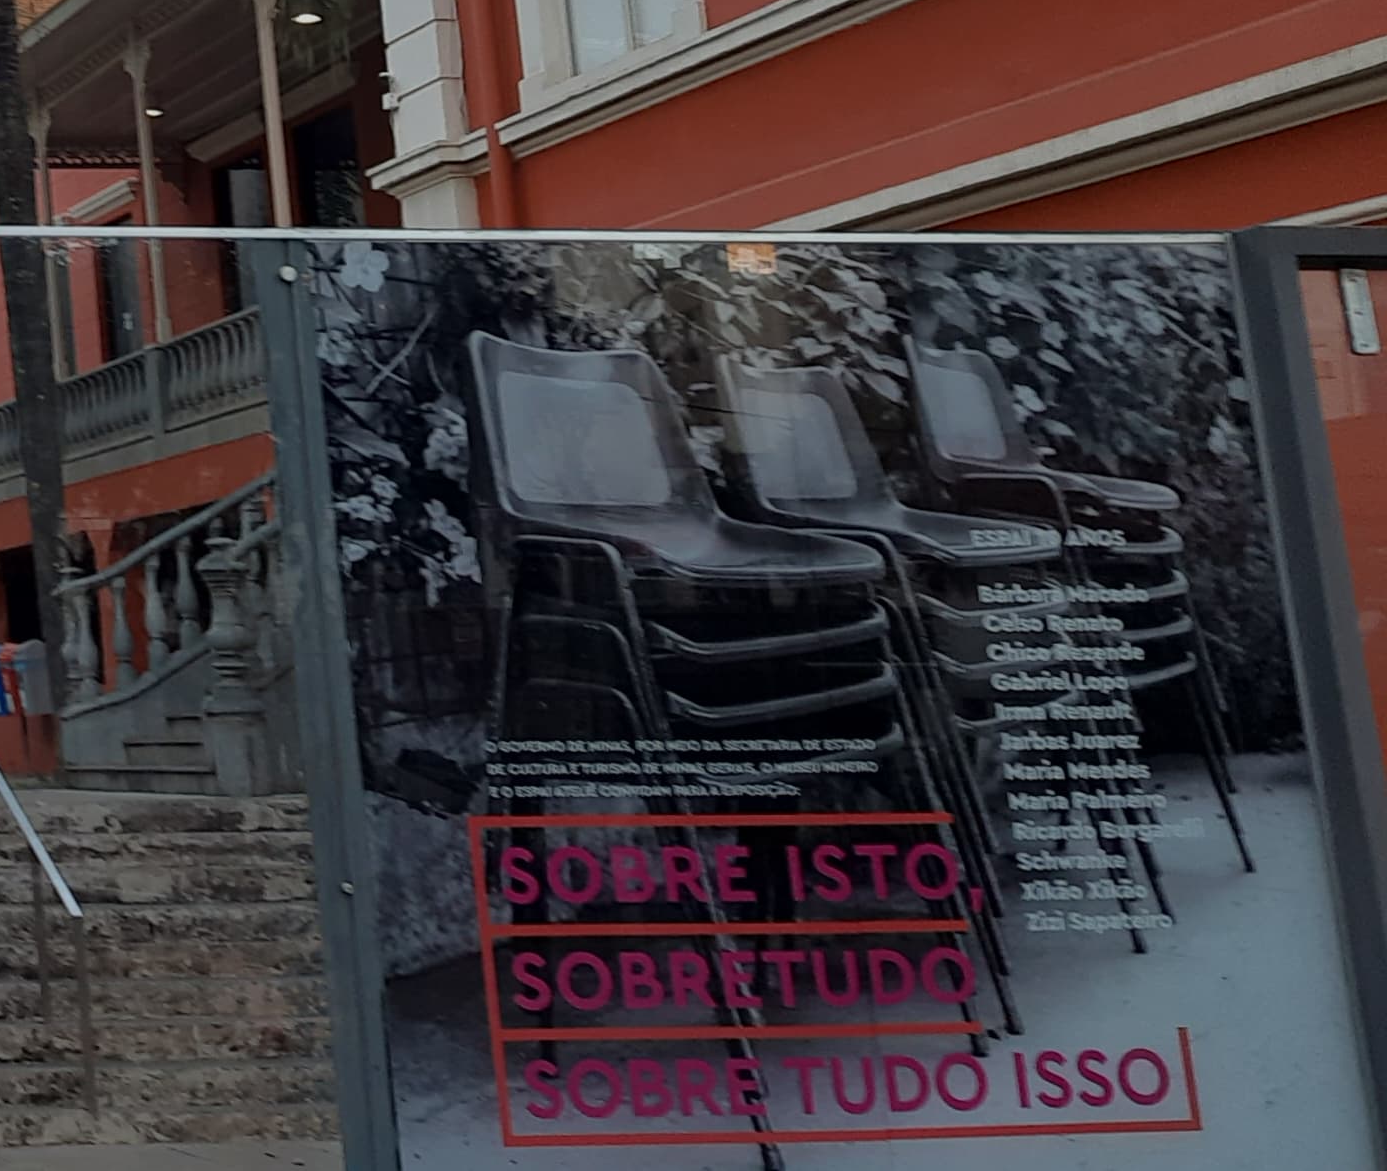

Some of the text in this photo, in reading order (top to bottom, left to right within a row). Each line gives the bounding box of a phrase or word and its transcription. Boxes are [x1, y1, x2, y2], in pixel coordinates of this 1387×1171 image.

[1064, 530, 1127, 548] ANOS
[976, 583, 1150, 603] Bárbara Macedo
[983, 613, 1125, 632] Celso Renato
[986, 641, 1050, 662] Chico
[990, 671, 1071, 691] Gabriel
[566, 740, 587, 753] DE
[999, 730, 1069, 750] Jarbas
[486, 763, 507, 776] DE
[507, 763, 569, 776] CULTURA
[1003, 759, 1152, 780] Maria Mendes
[1007, 789, 1070, 810] Maria
[1011, 819, 1097, 840] Ricardo
[500, 841, 985, 913] SOBRE ISTO,
[511, 947, 978, 1011] SOBRETUDO
[524, 1046, 1170, 1120] SOBRE TUDO ISSO
